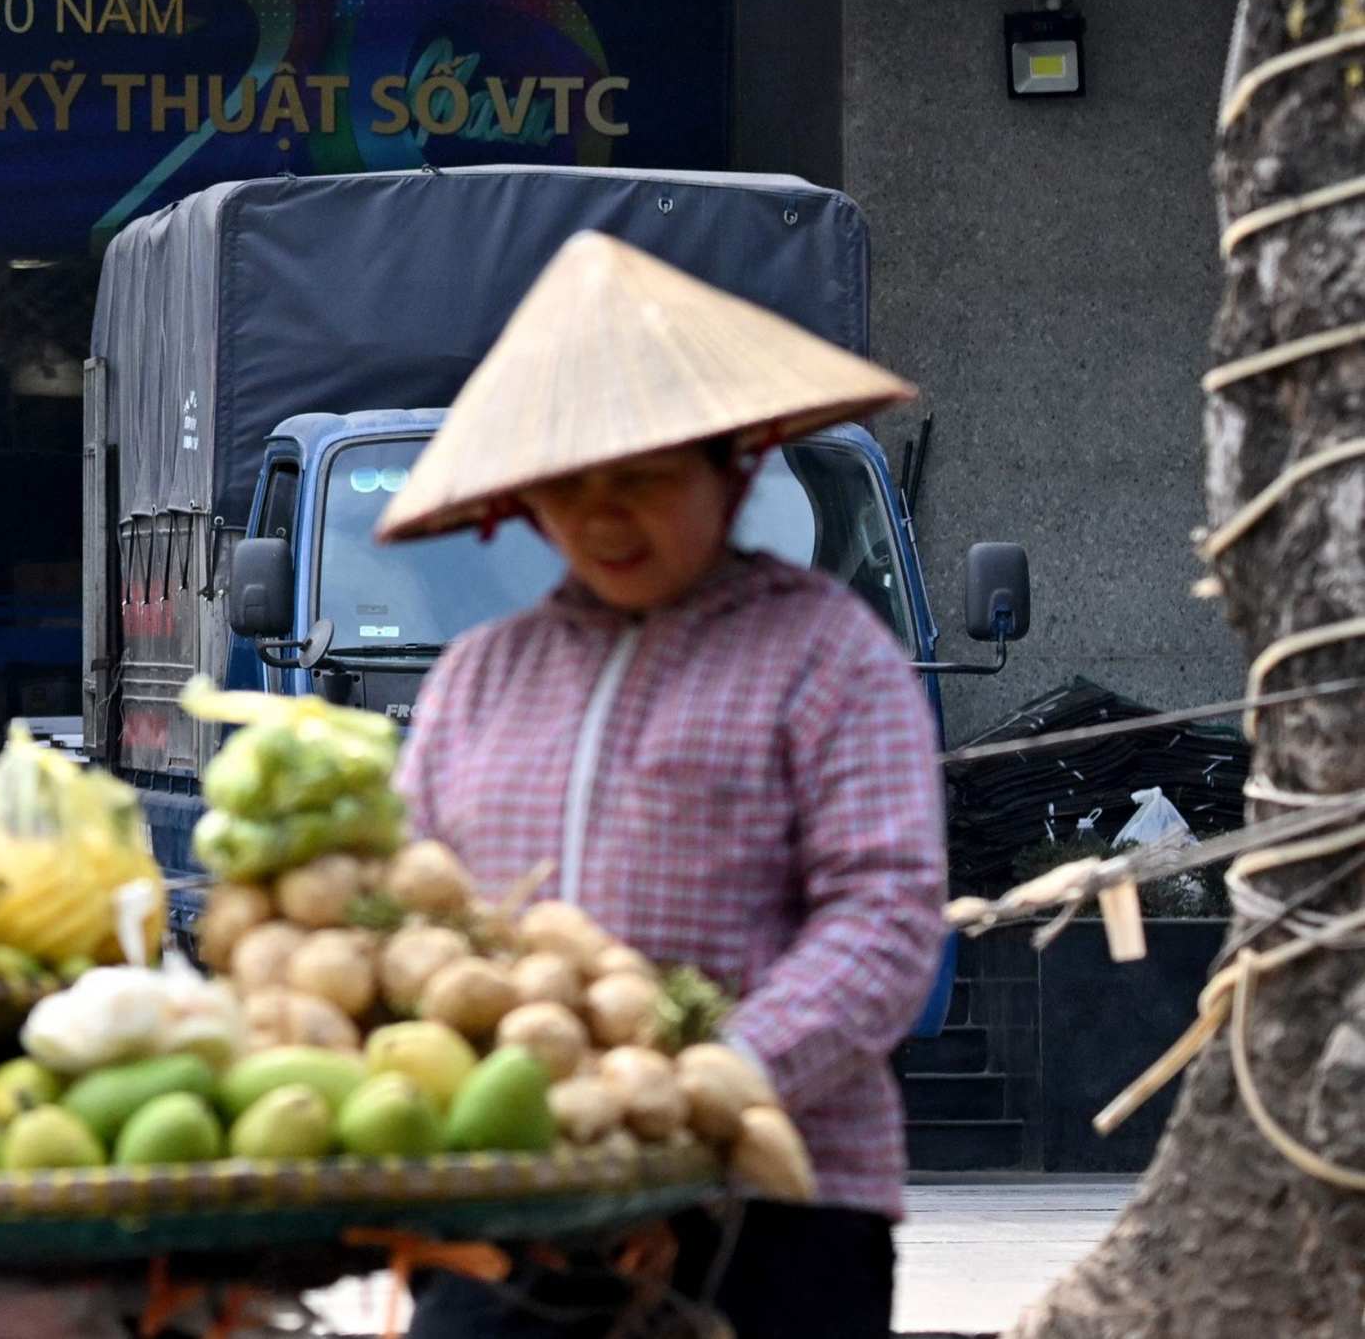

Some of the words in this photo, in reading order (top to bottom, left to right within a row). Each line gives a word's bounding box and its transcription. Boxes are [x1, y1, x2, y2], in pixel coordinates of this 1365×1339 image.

[101, 64, 350, 151] THUẬT
[371, 53, 470, 137] SỐ
[485, 75, 631, 137] VTC
